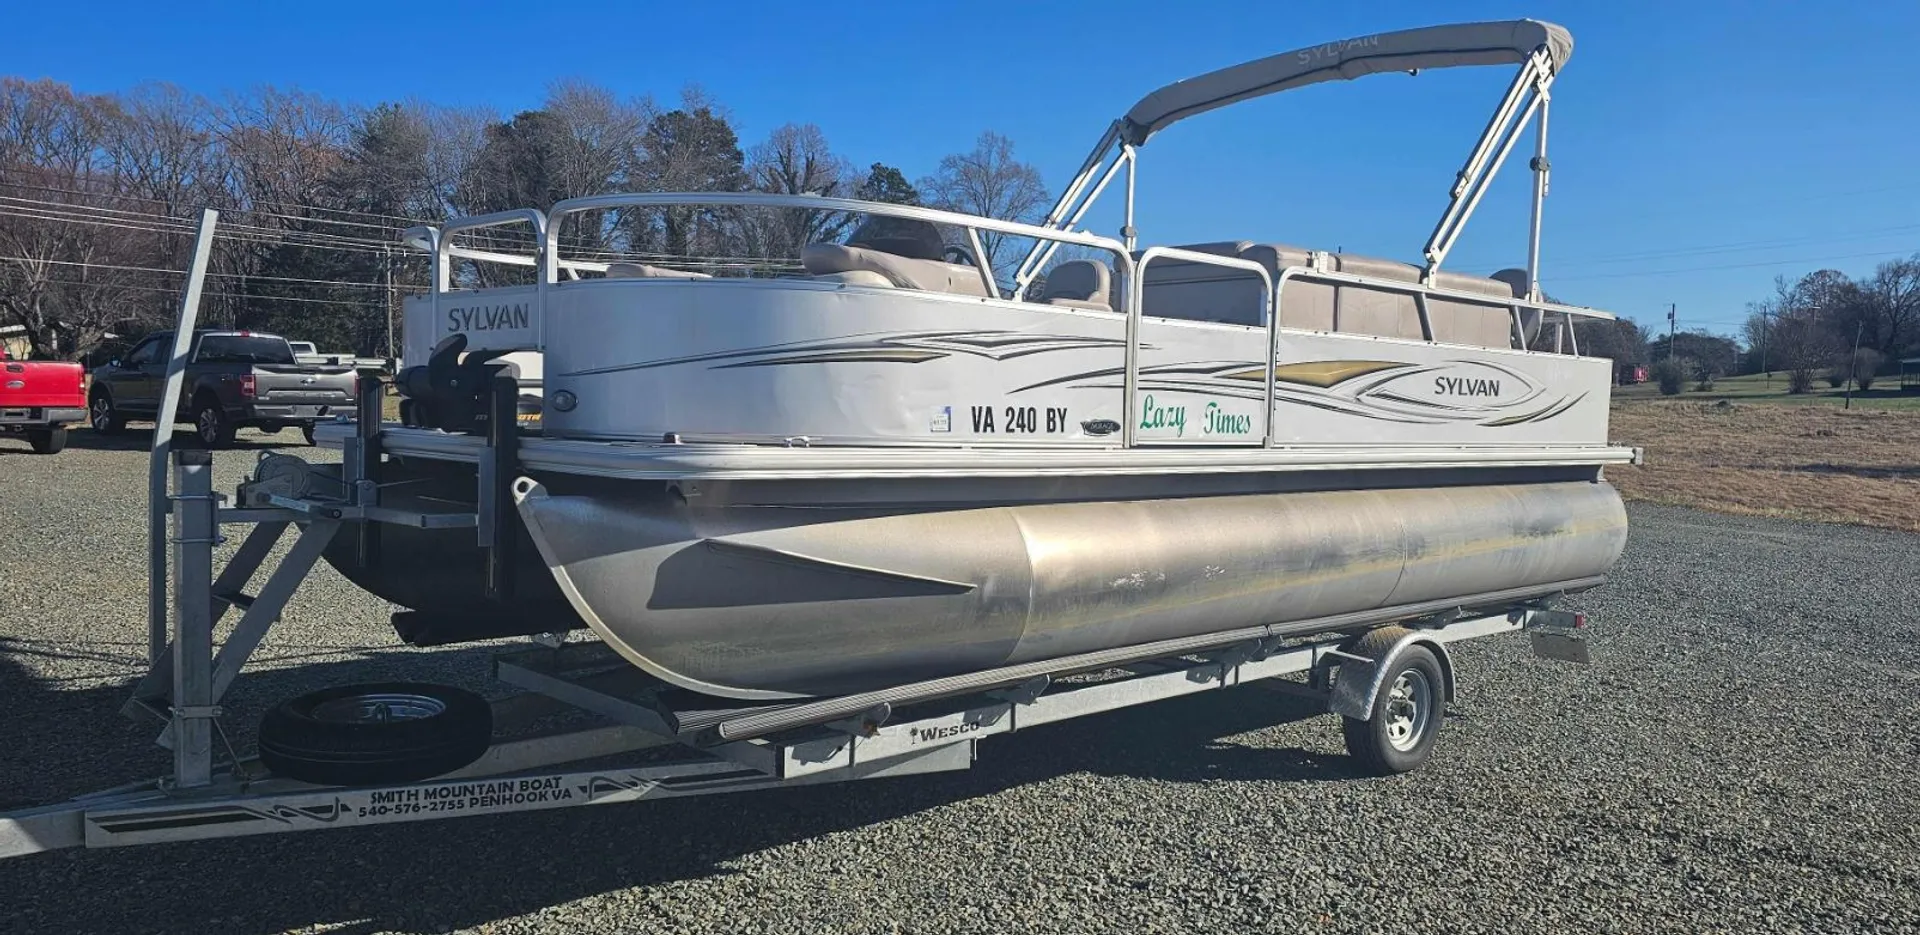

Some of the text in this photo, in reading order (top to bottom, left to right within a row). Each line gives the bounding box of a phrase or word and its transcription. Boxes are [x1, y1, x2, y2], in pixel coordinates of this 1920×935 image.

[1297, 35, 1378, 64] SYLVAN
[448, 303, 529, 332] SYLVAN
[1434, 376, 1500, 397] SYLVAN
[971, 406, 995, 433] VA
[1005, 406, 1037, 433] 240
[1046, 407, 1068, 433] BY
[1140, 394, 1251, 438] Lazy Times
[920, 721, 980, 742] WESCO
[358, 787, 572, 817] 540-576-2755 PENHOOK VA
[371, 776, 563, 804] SMITH MOUNTAIN BOAT
